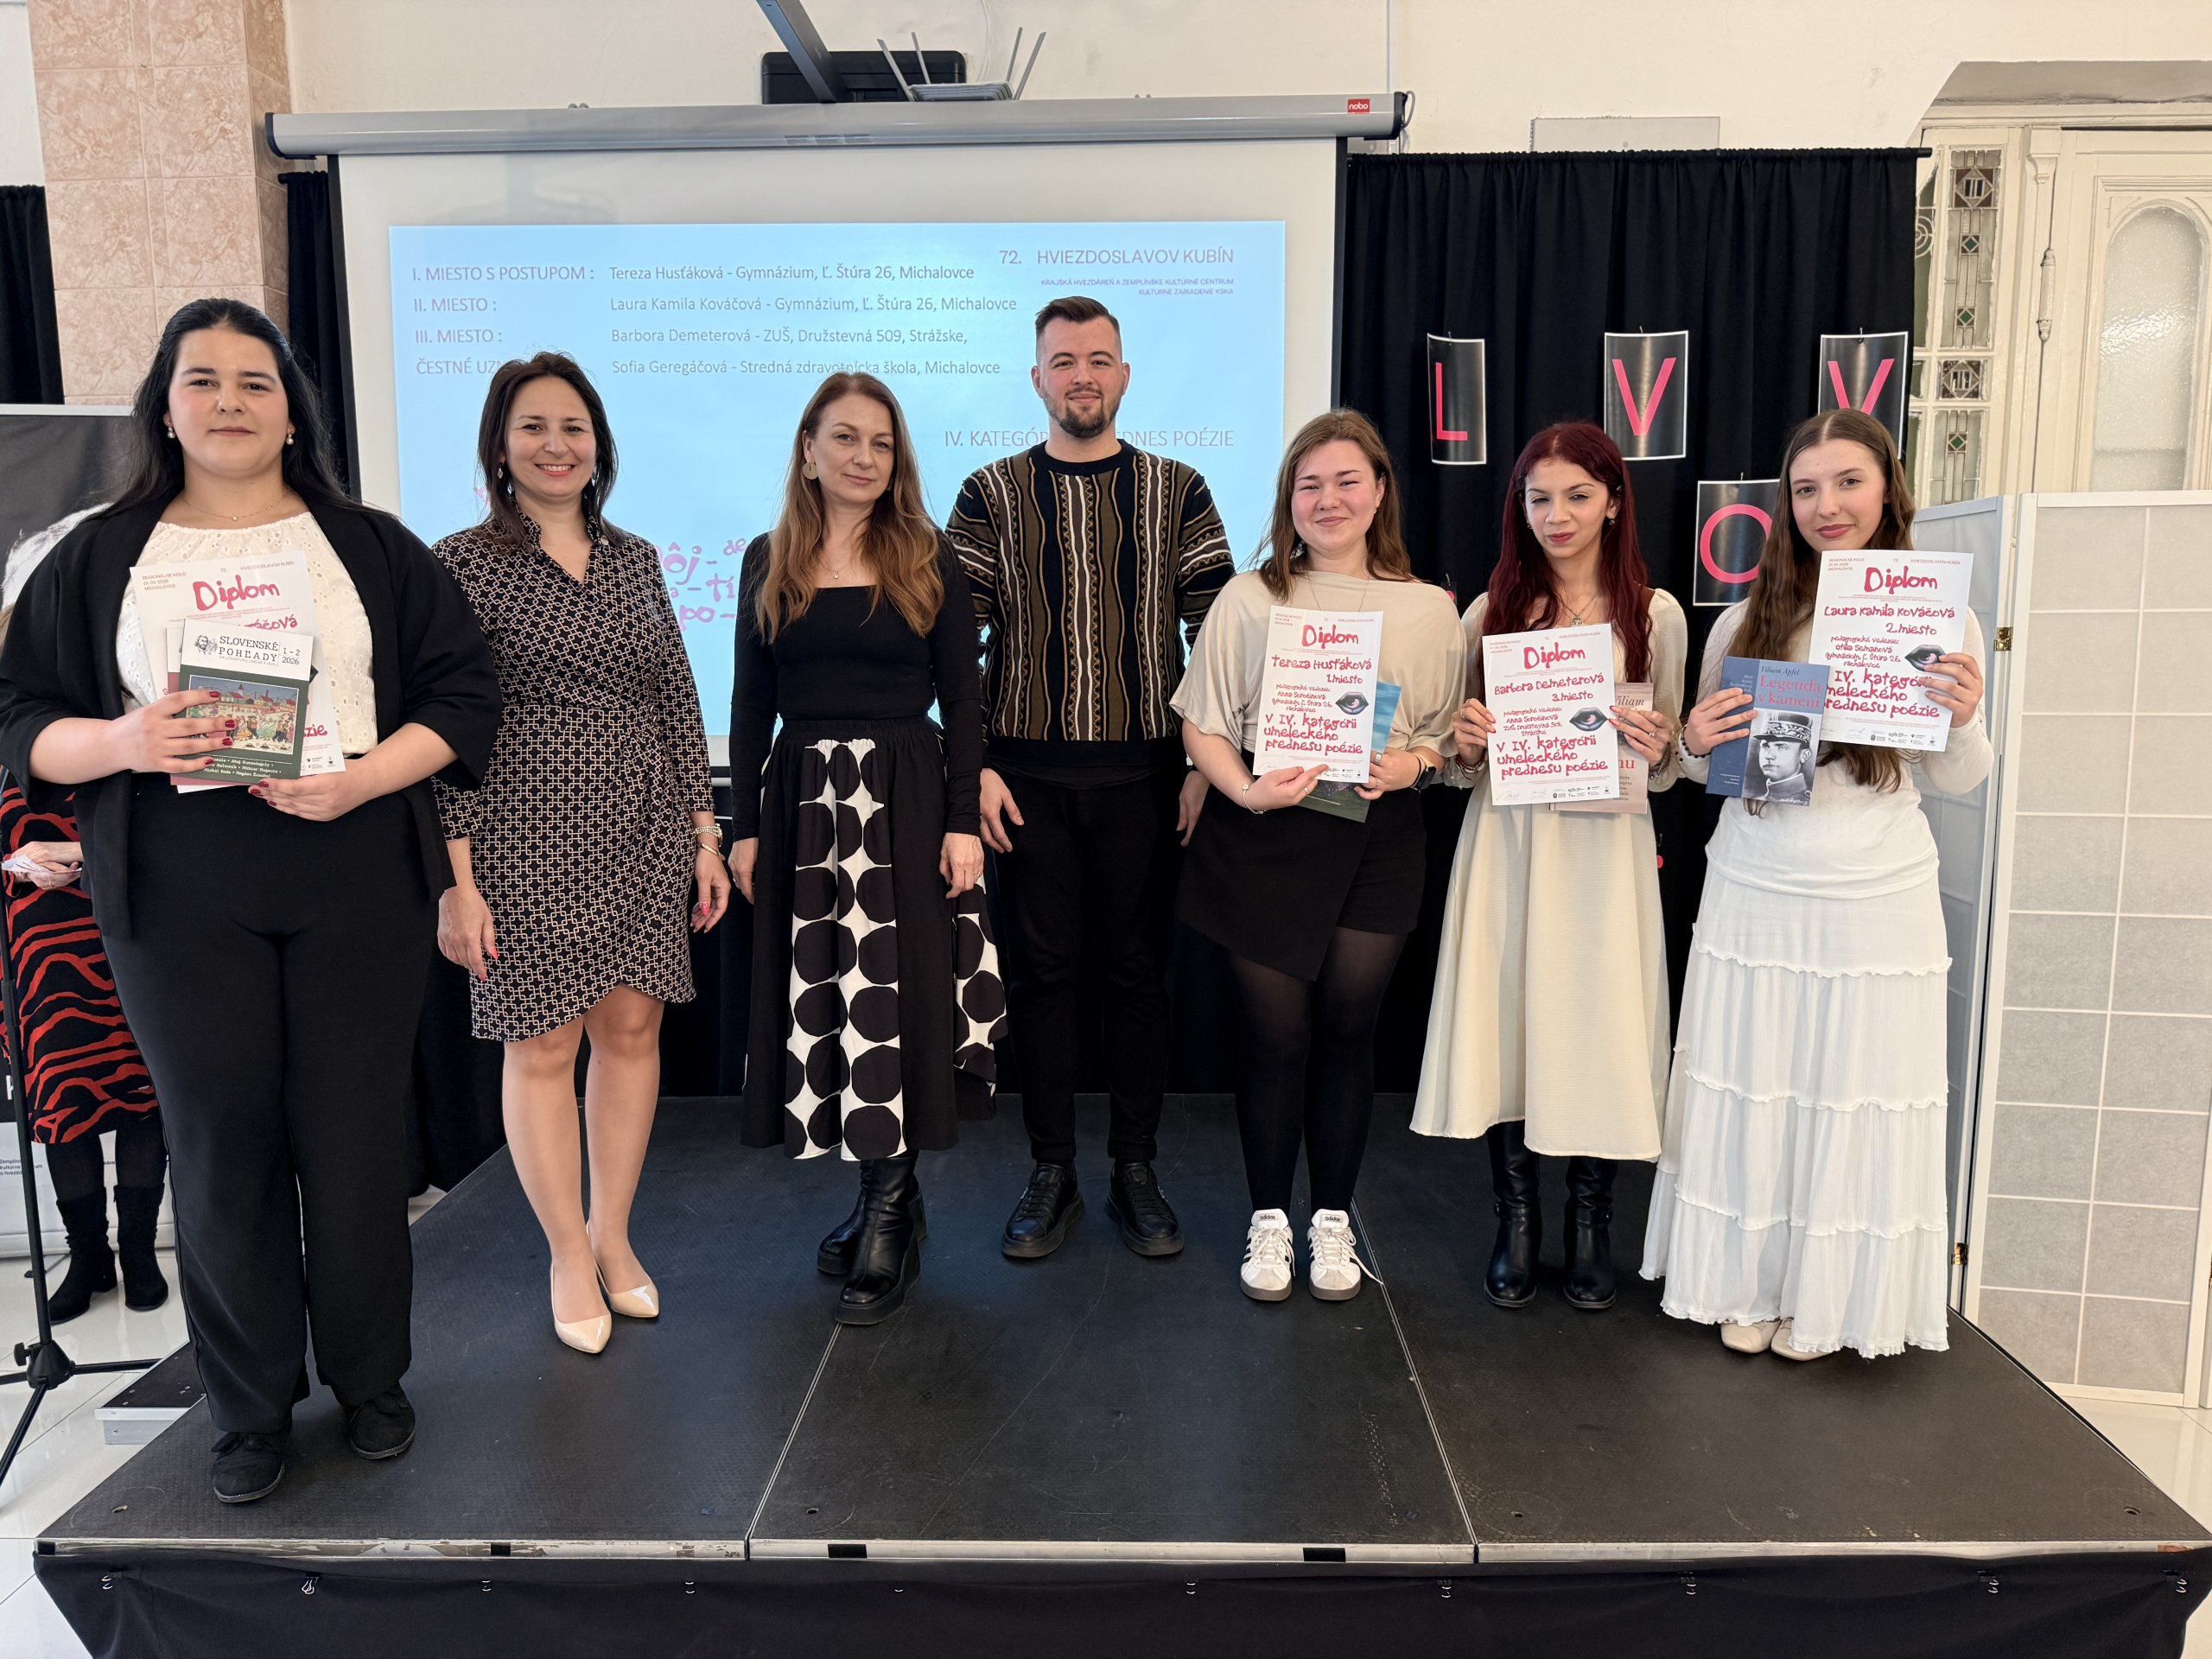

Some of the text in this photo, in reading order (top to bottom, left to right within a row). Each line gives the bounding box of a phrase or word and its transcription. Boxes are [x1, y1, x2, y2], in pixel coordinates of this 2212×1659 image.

[999, 245, 1234, 264] 72. HVIEZDOSLAVOV KUBÍN
[412, 267, 421, 281] I.
[426, 267, 482, 281] MIESTO
[486, 267, 495, 280] S
[499, 266, 585, 280] POSTUPOM
[609, 266, 651, 279] Tereza
[656, 266, 723, 279] Husťáková
[736, 265, 818, 282] Gymnázium,
[822, 265, 832, 279] Ľ.
[836, 263, 871, 279] Štúra
[874, 265, 895, 281] 26,
[899, 265, 975, 279] Michalovce
[414, 298, 427, 312] II.
[432, 297, 488, 312] MIESTO
[611, 297, 647, 311] Laura
[652, 297, 696, 311] Kamila
[700, 296, 762, 311] Kováčová
[775, 296, 858, 313] Gymnázium,
[863, 297, 873, 311] Ľ.
[877, 294, 912, 311] Štúra
[917, 297, 938, 312] 26,
[941, 296, 1017, 311] Michalovce
[415, 329, 432, 343] III.
[437, 329, 493, 343] MIESTO
[612, 328, 664, 342] Barbora
[669, 328, 751, 342] Demeterová
[763, 326, 794, 344] ZUŠ,
[798, 328, 872, 342] Družstevná
[876, 329, 906, 344] 509,
[909, 328, 968, 344] Strážske,
[416, 357, 473, 374] ČESTNÉ
[612, 360, 645, 373] Sofia
[649, 359, 727, 375] Geregáčová
[740, 360, 791, 373] Stredná
[796, 360, 879, 374] zdravotnícka
[883, 360, 920, 376] škola,
[925, 360, 1001, 374] Michalovce
[1435, 362, 1468, 441] L
[1611, 357, 1676, 436] V
[945, 427, 1235, 447] IV. KATEGÓR DNES POÉZIE
[1700, 504, 1773, 584] O
[1864, 565, 1938, 594] Diplom
[193, 575, 280, 611] Diplom
[1824, 603, 1955, 619] Laura Kamila Kováčová
[219, 635, 278, 652] SLOVENSKÉ
[1301, 624, 1359, 649] Diplom
[218, 646, 278, 662] POHĽADY
[282, 656, 300, 665] 2026
[1271, 654, 1372, 671] Tereza Husťáková
[1523, 641, 1586, 670] Diplom
[1494, 683, 1534, 695] Barbora
[1535, 672, 1605, 690] Demeterová
[1759, 676, 1822, 693] Legenda
[1834, 670, 1855, 683] IV.
[1758, 694, 1764, 702] v
[1827, 681, 1908, 702] meleckého
[1824, 698, 1940, 718] rednesu poézie
[1279, 714, 1296, 725] IV.
[1302, 712, 1357, 731] kategórii
[1263, 724, 1338, 741] umeleckého
[1265, 739, 1363, 756] prednesu poézie
[1511, 740, 1531, 751] IV.
[1537, 734, 1597, 750] kategórii
[1497, 747, 1578, 765] umeleckého
[1501, 764, 1562, 781] prednesu
[1566, 759, 1608, 776] poézie
